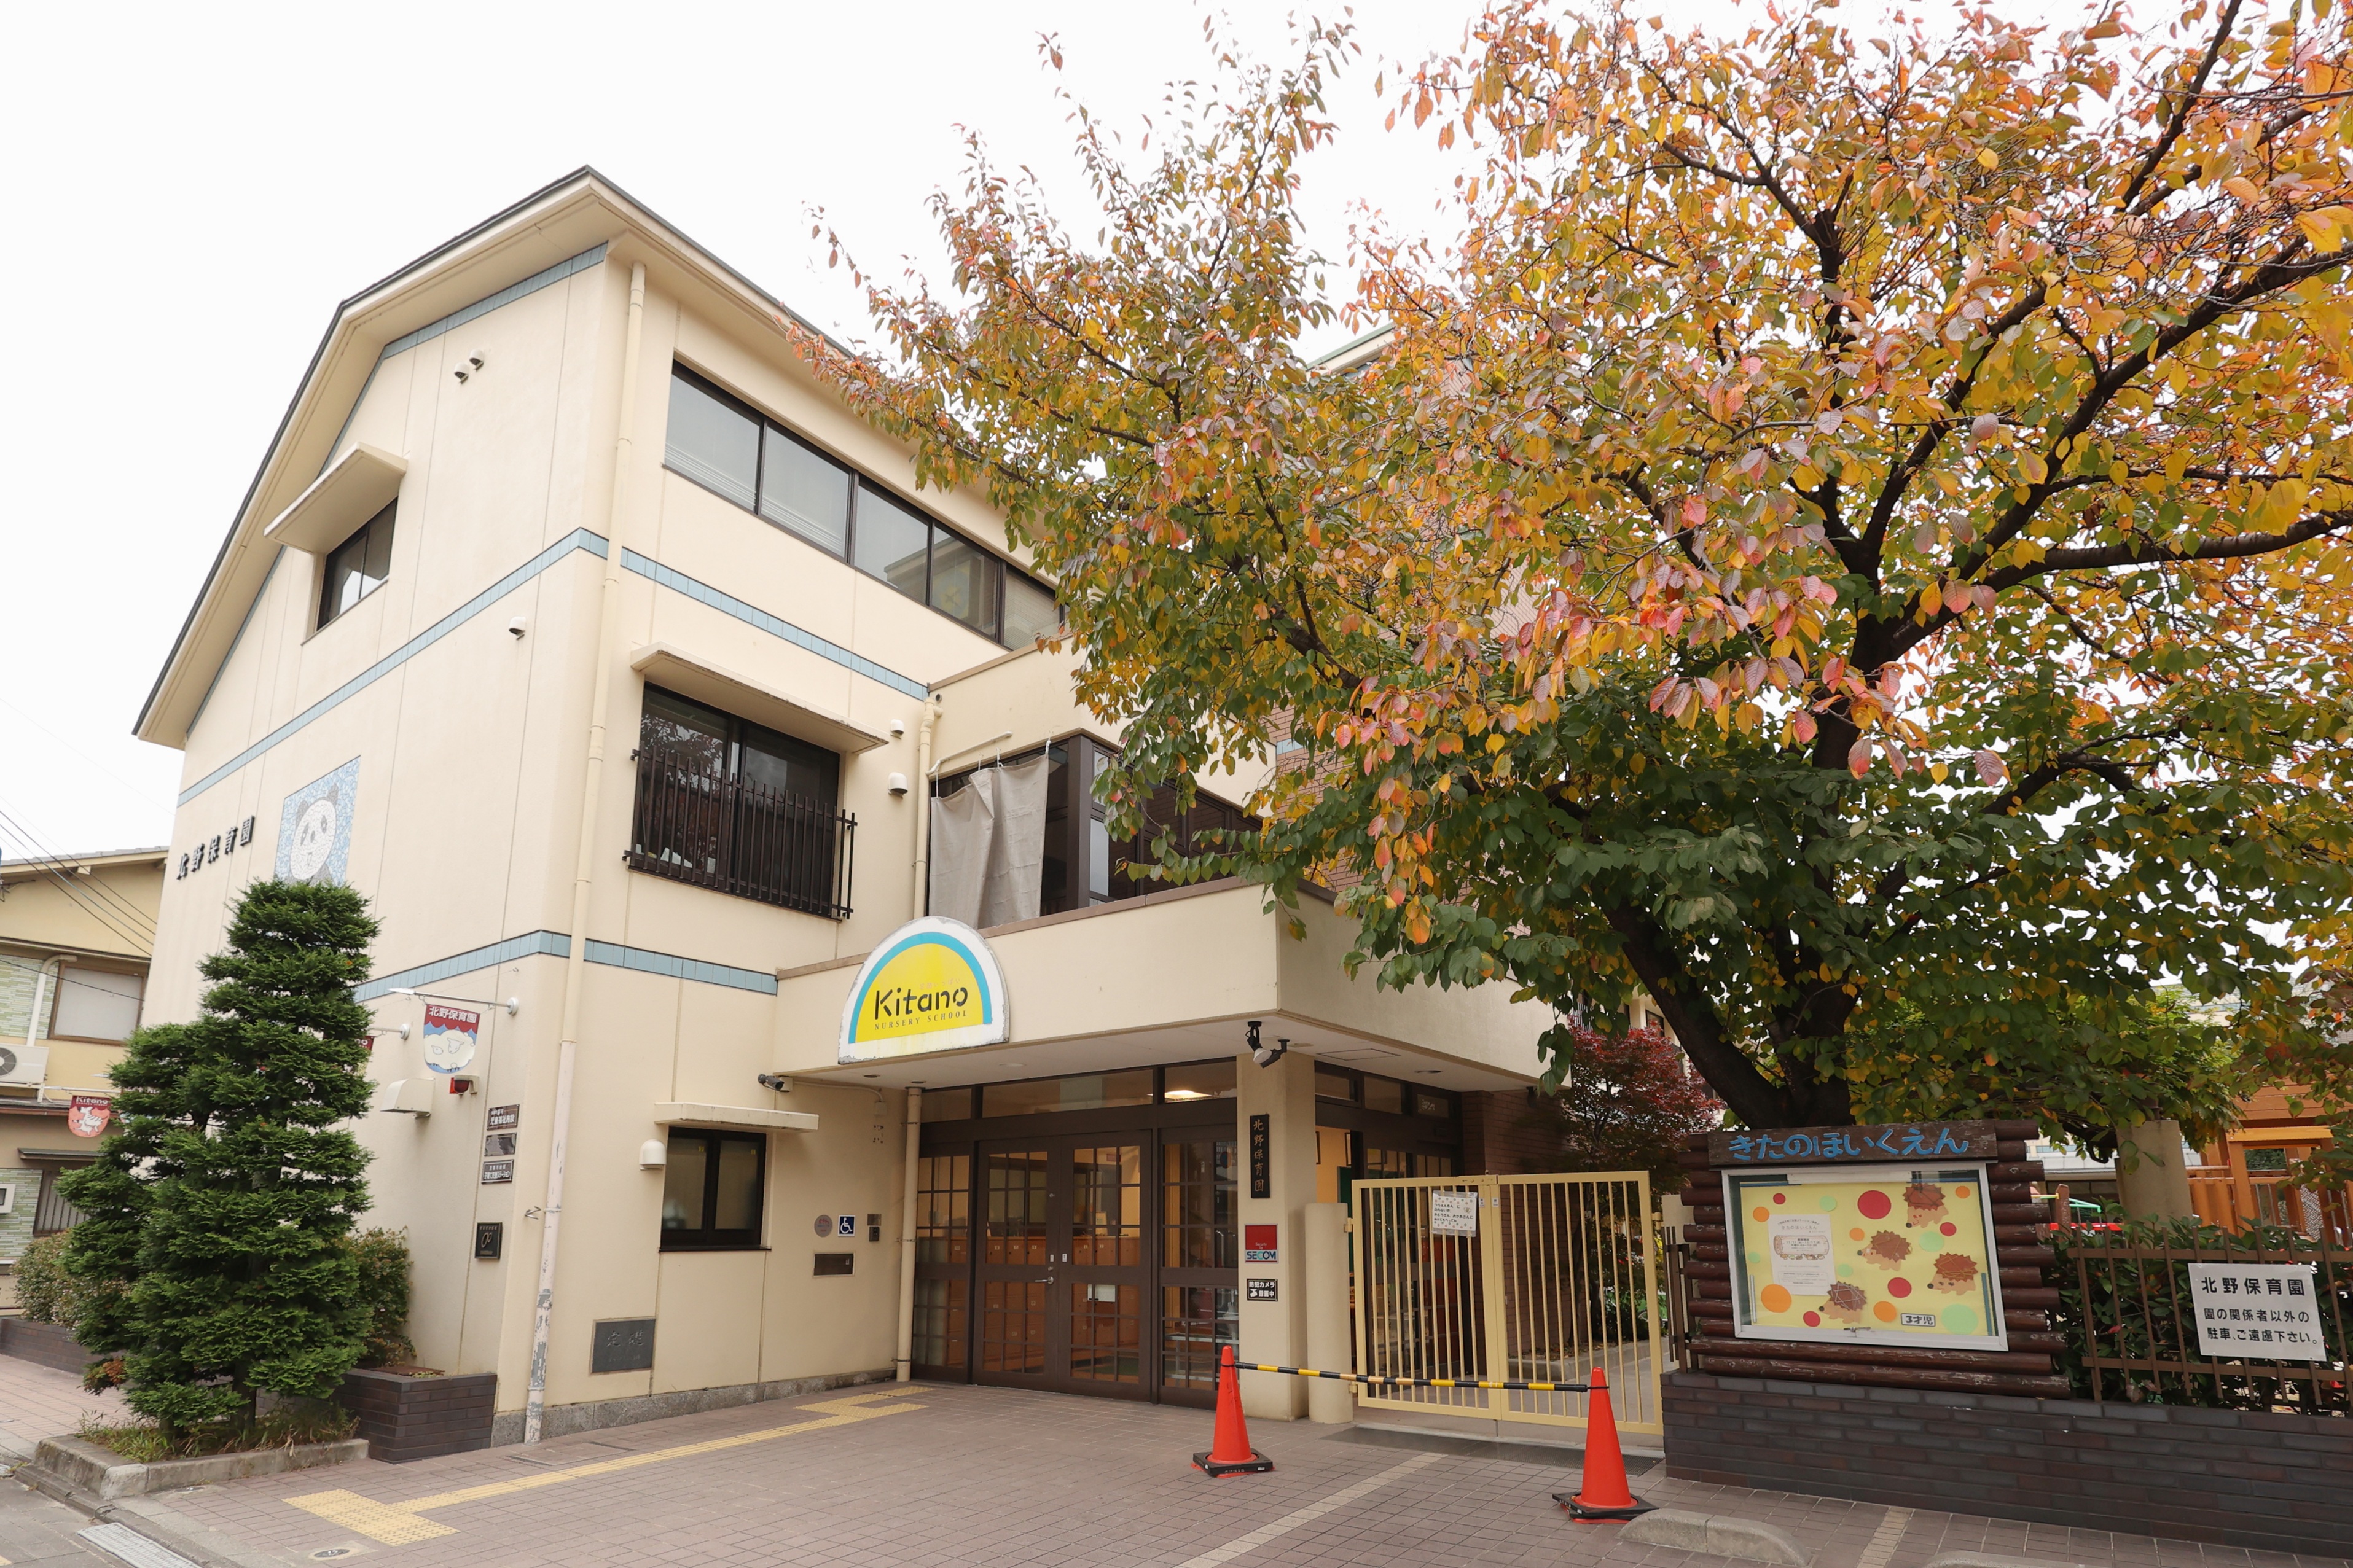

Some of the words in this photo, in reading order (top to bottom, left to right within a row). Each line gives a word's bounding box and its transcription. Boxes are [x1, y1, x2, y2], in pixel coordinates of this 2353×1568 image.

[176, 815, 255, 880] 北野保育園
[875, 987, 968, 1020] Kitano
[428, 1006, 478, 1023] 北野保育園
[875, 1017, 920, 1030] NURSERY
[927, 1010, 967, 1022] SCHOOL
[1729, 1128, 1968, 1161] きたのほいくえん
[1253, 1119, 1264, 1192] 北野保育園
[1247, 1250, 1276, 1260] SECOM
[2201, 1277, 2305, 1296] 北野保育園
[1906, 1316, 1933, 1325] 3才児
[2204, 1308, 2309, 1323] 園の関係者以外の
